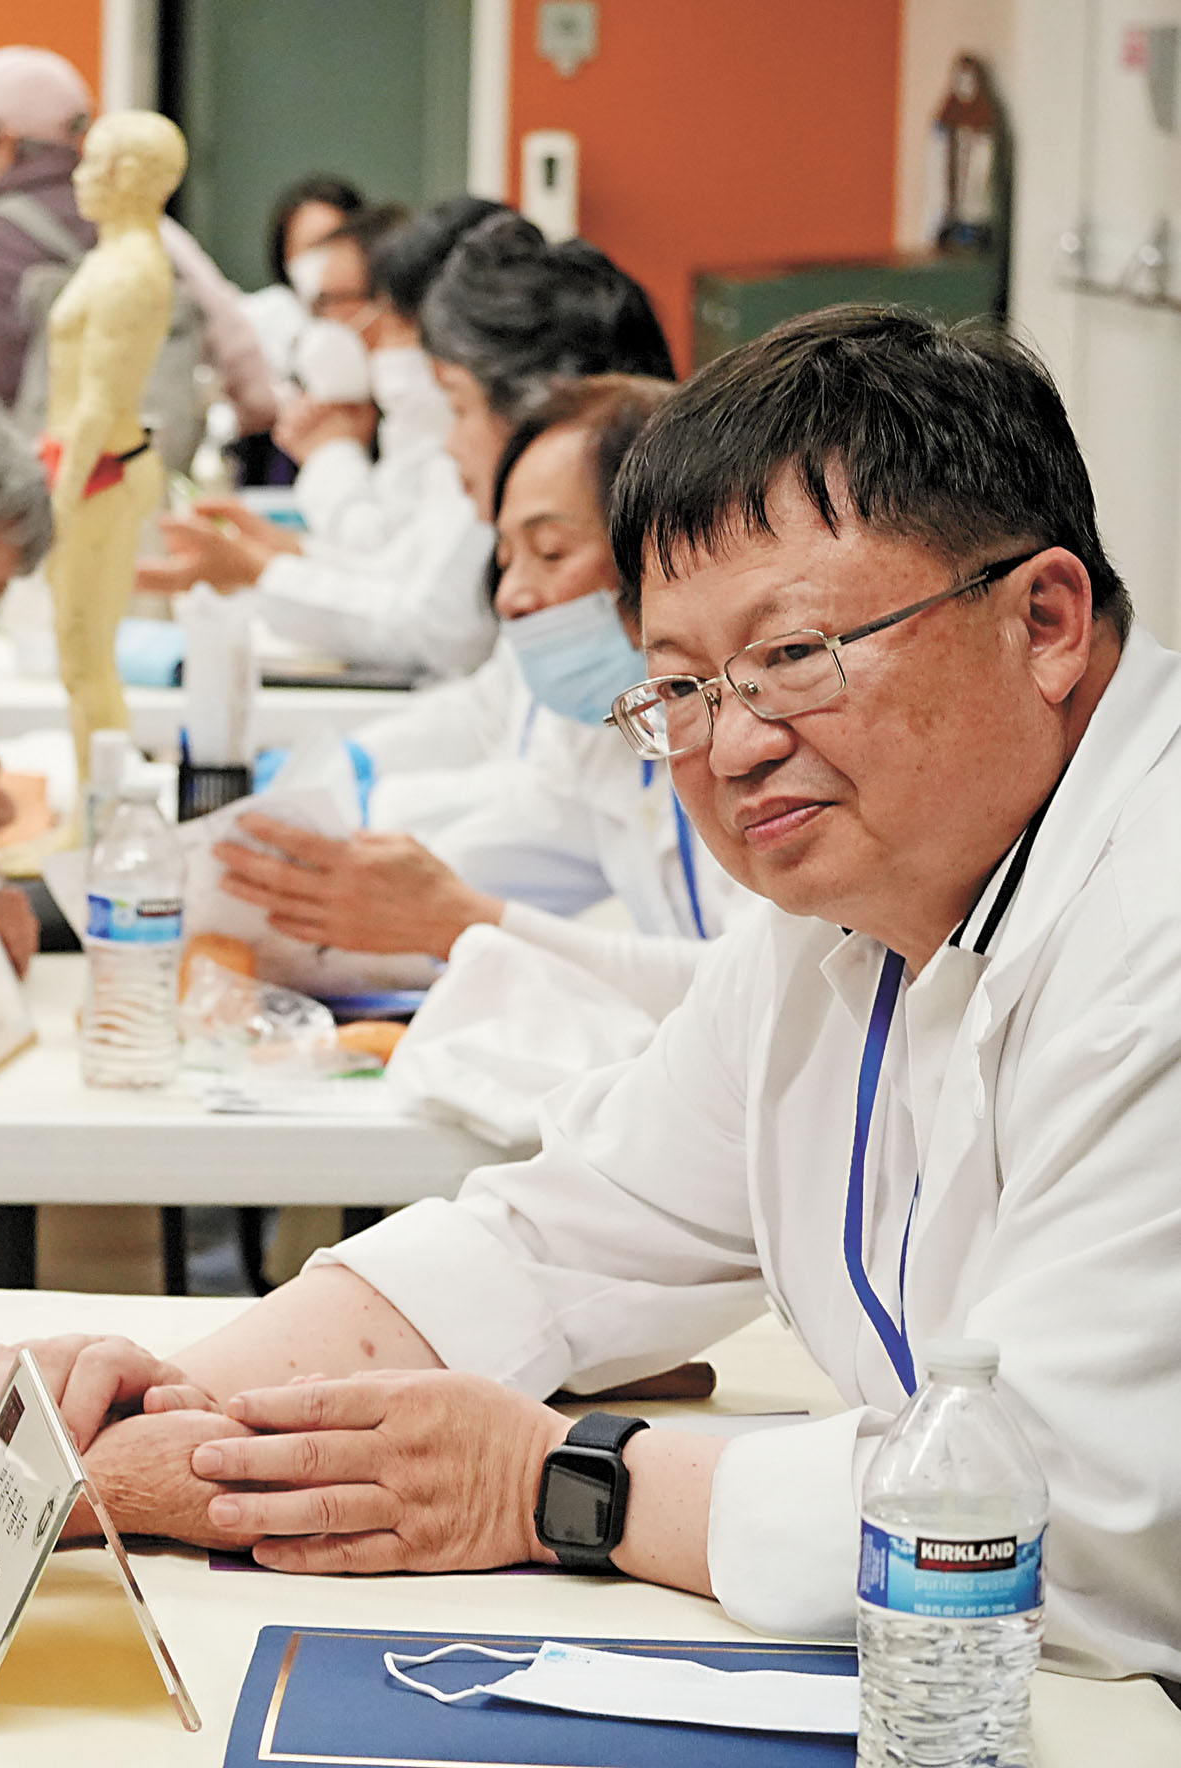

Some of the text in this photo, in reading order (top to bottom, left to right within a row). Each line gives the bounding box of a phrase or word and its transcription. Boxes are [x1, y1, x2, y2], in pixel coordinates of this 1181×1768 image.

[920, 1541, 1015, 1562] KIRKLAND
[914, 1575, 1017, 1592] purified water
